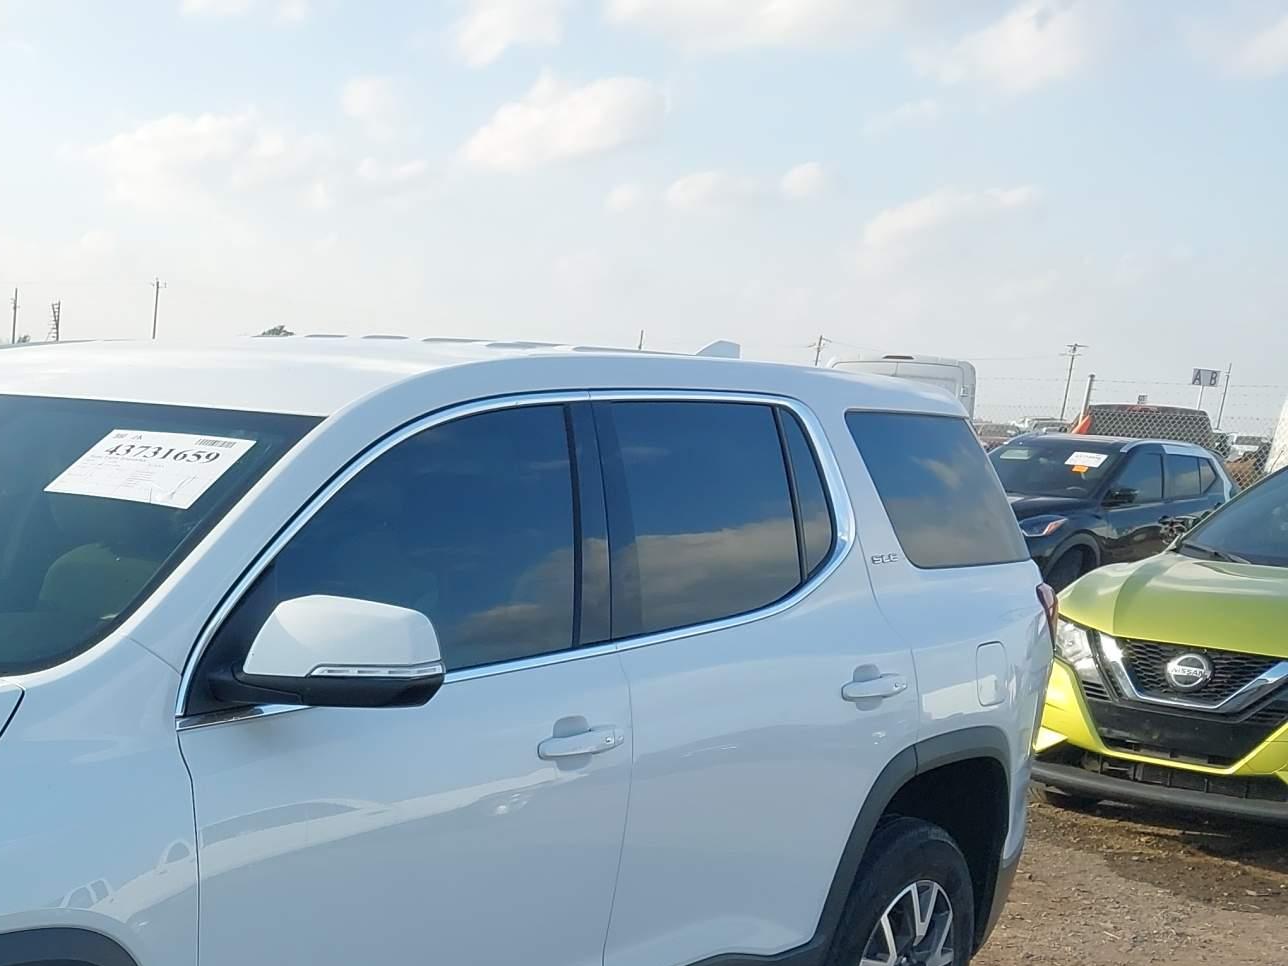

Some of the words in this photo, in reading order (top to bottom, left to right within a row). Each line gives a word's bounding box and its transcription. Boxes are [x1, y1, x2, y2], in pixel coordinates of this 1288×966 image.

[1192, 369, 1202, 386] A
[1209, 371, 1218, 386] B
[105, 443, 221, 464] 43731659
[871, 553, 899, 565] SLE
[1172, 667, 1205, 678] NISSAN
